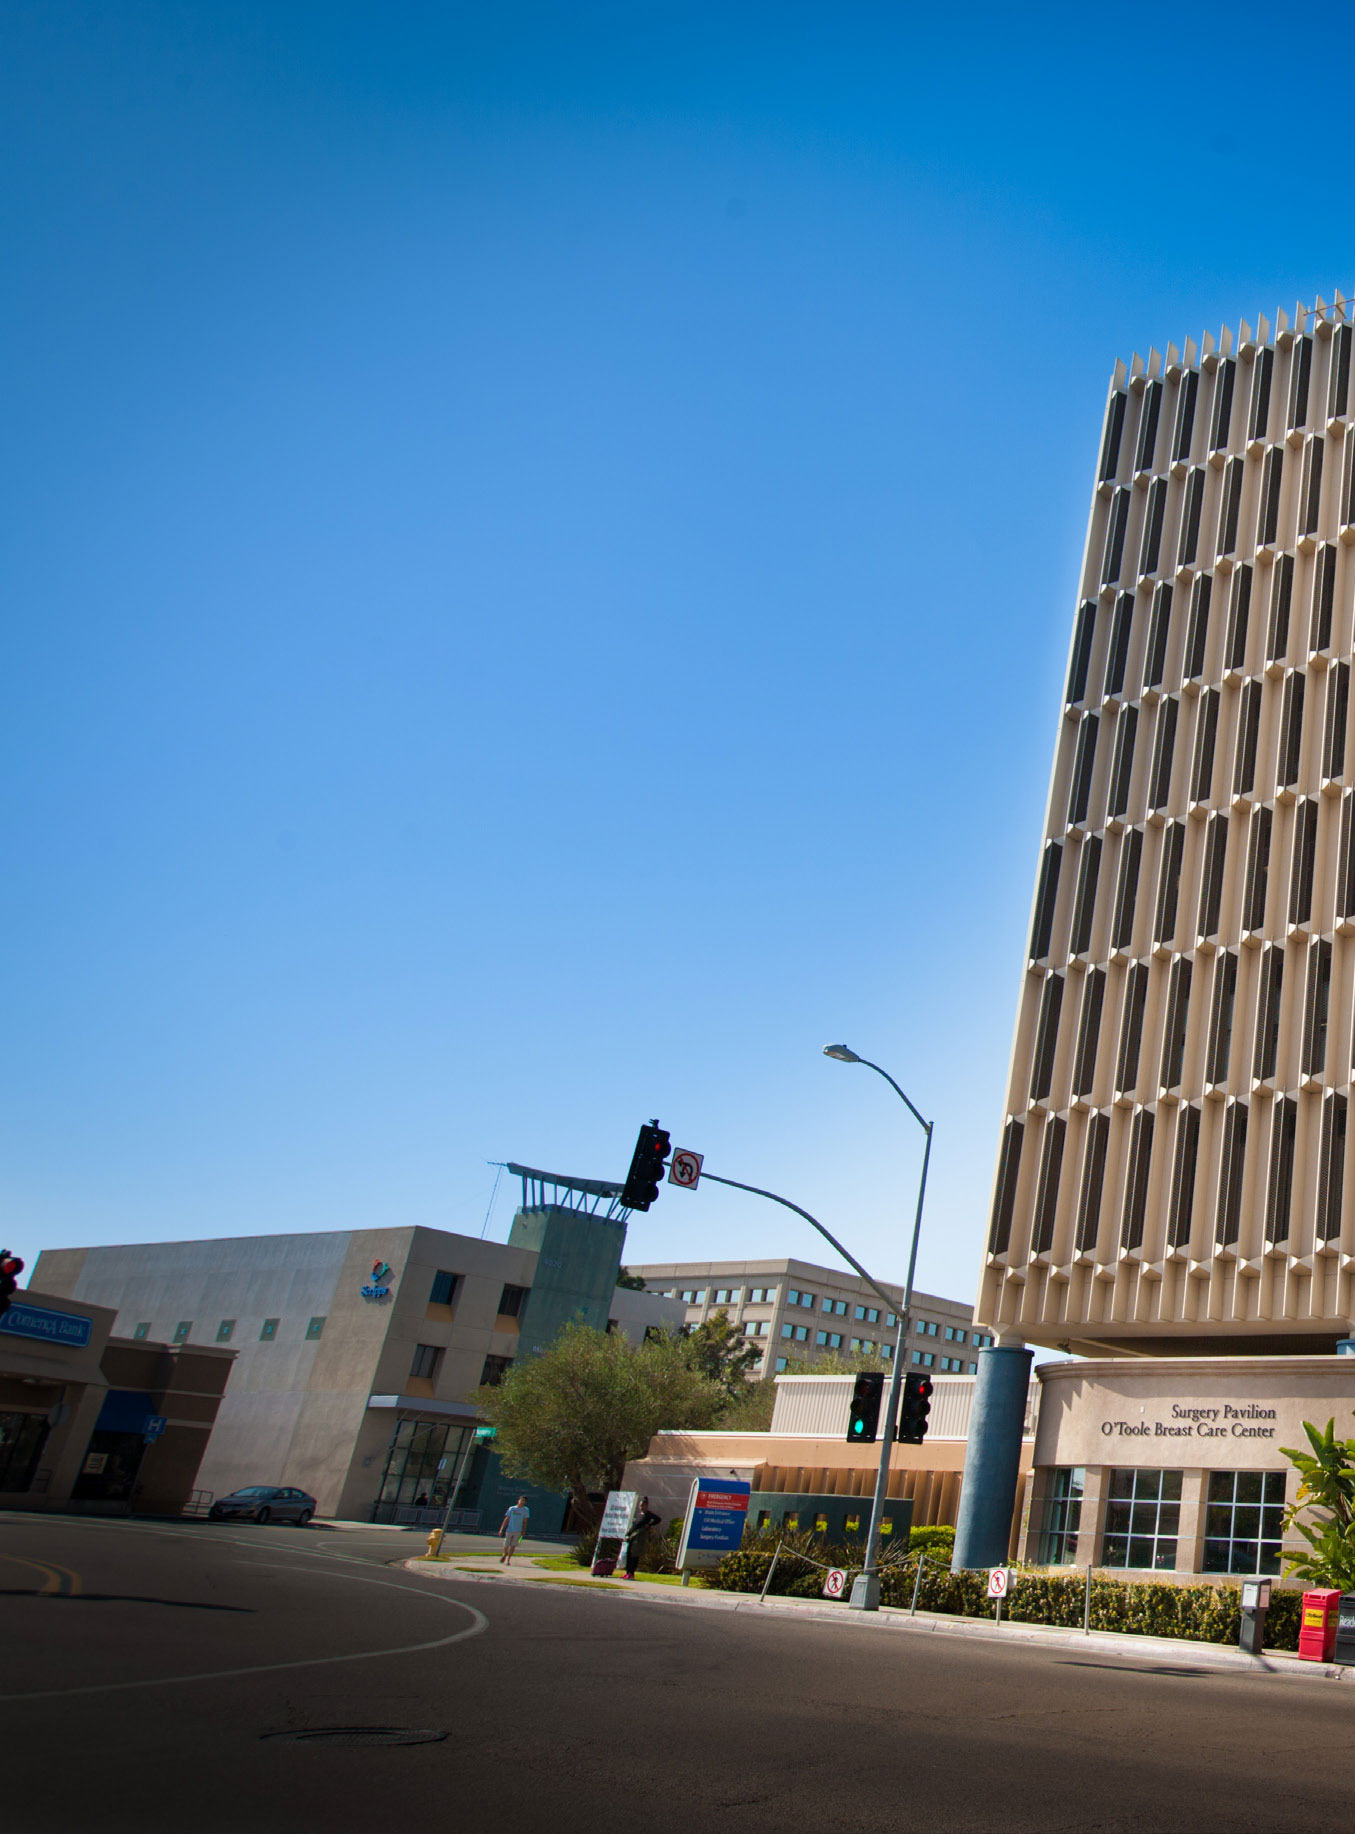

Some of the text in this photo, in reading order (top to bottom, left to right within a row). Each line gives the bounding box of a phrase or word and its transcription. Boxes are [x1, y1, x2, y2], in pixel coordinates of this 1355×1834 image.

[1171, 1404, 1276, 1421] Surgery Pavilion
[147, 1418, 161, 1432] H
[1101, 1421, 1275, 1437] O'Toole Breast Care Center
